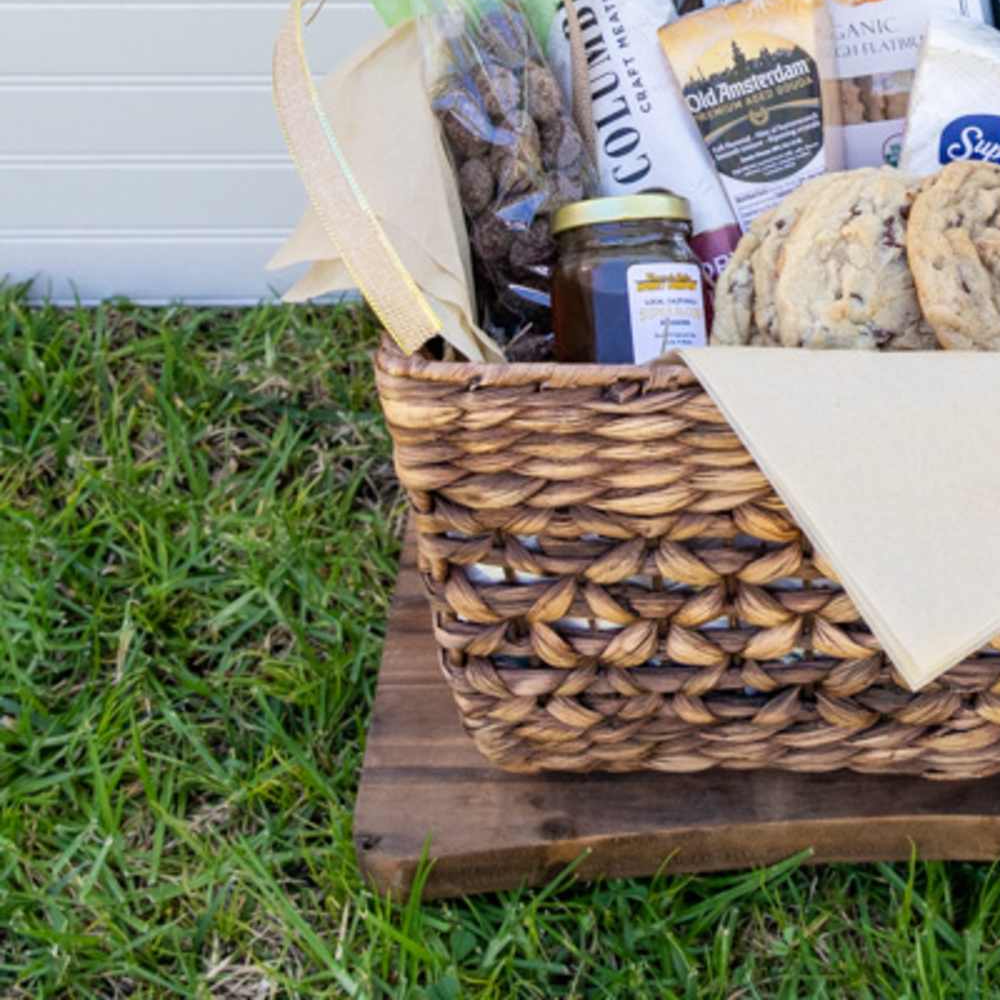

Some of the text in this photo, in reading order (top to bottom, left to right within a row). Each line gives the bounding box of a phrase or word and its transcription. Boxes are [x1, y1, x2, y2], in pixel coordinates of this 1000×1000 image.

[623, 56, 652, 113] CRAFT
[686, 59, 811, 113] Old Amsterdam
